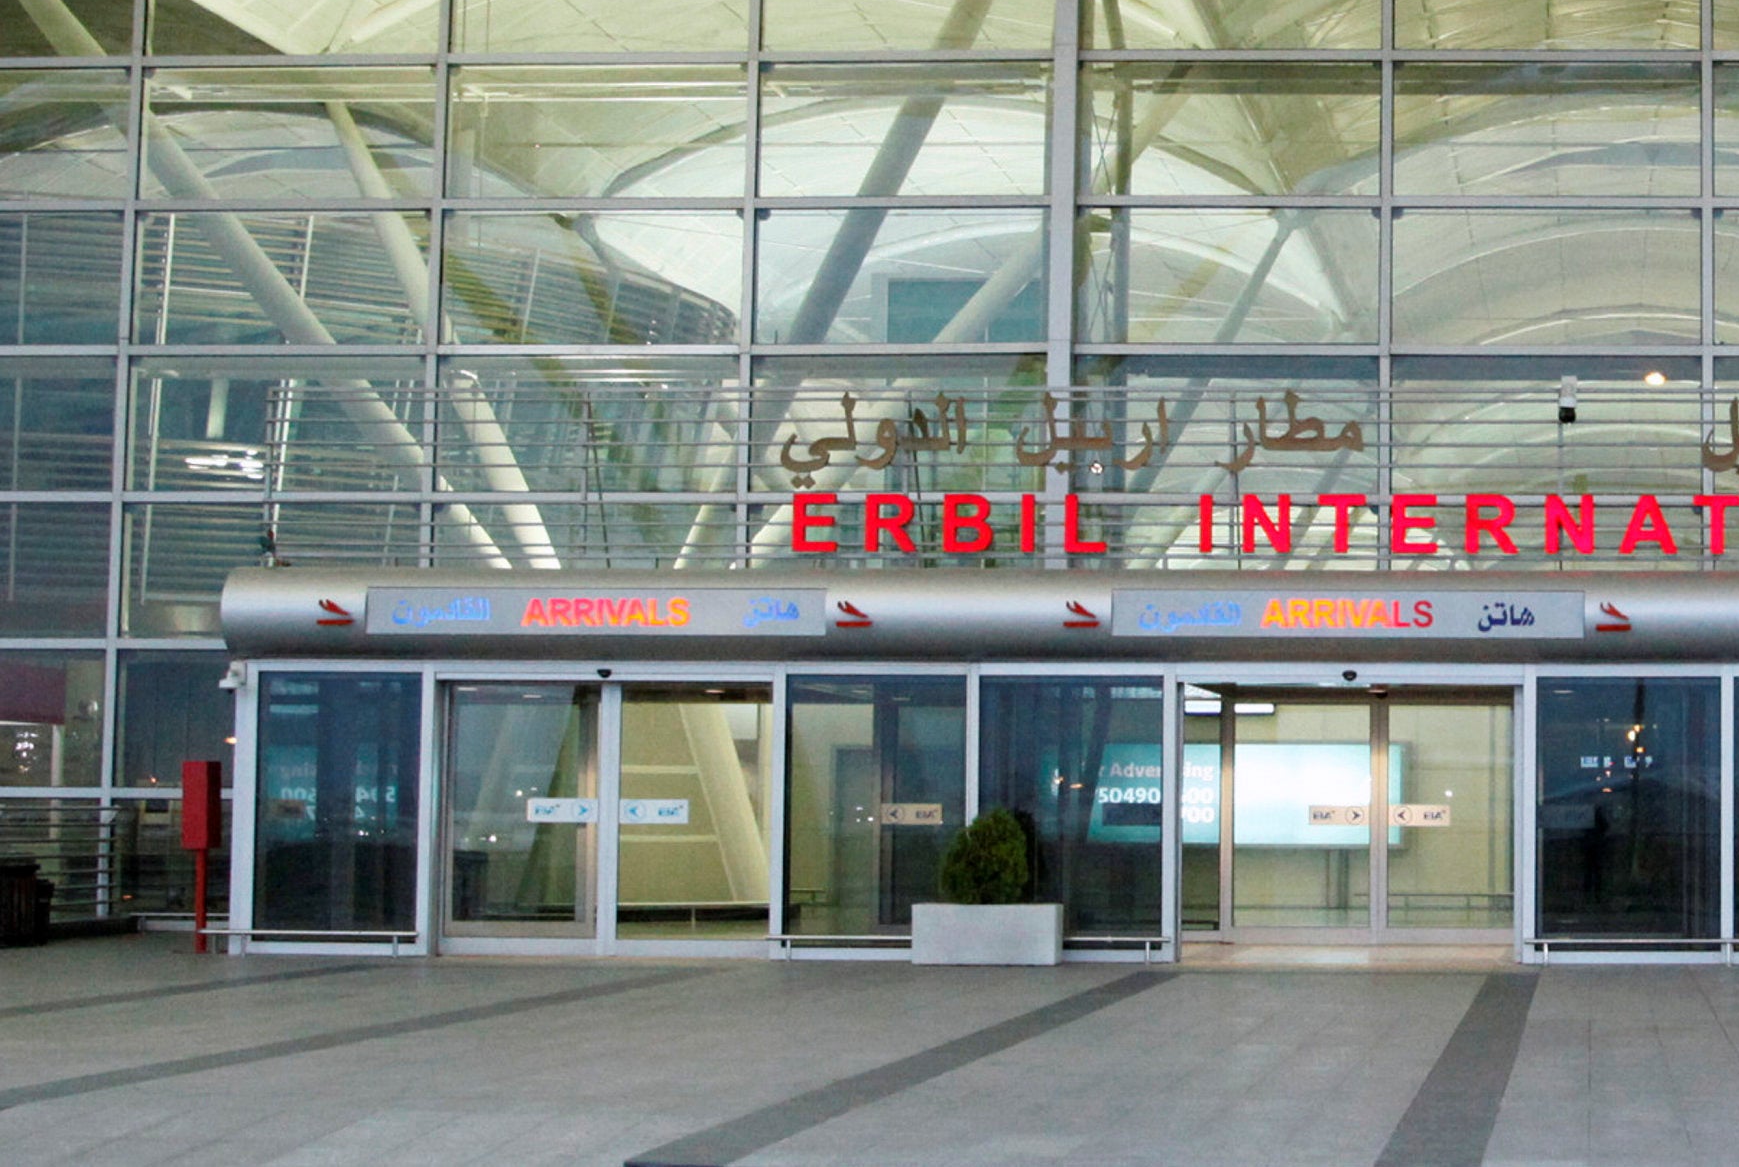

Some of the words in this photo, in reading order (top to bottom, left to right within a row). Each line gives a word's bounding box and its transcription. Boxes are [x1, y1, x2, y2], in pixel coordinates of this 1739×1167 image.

[780, 390, 967, 489] الدولي
[1215, 387, 1364, 473] مطار
[790, 492, 1107, 553] ERBIL
[521, 597, 691, 627] ARRIVALS
[1260, 598, 1434, 628] ARRIVALS
[1477, 601, 1535, 631] هاتن
